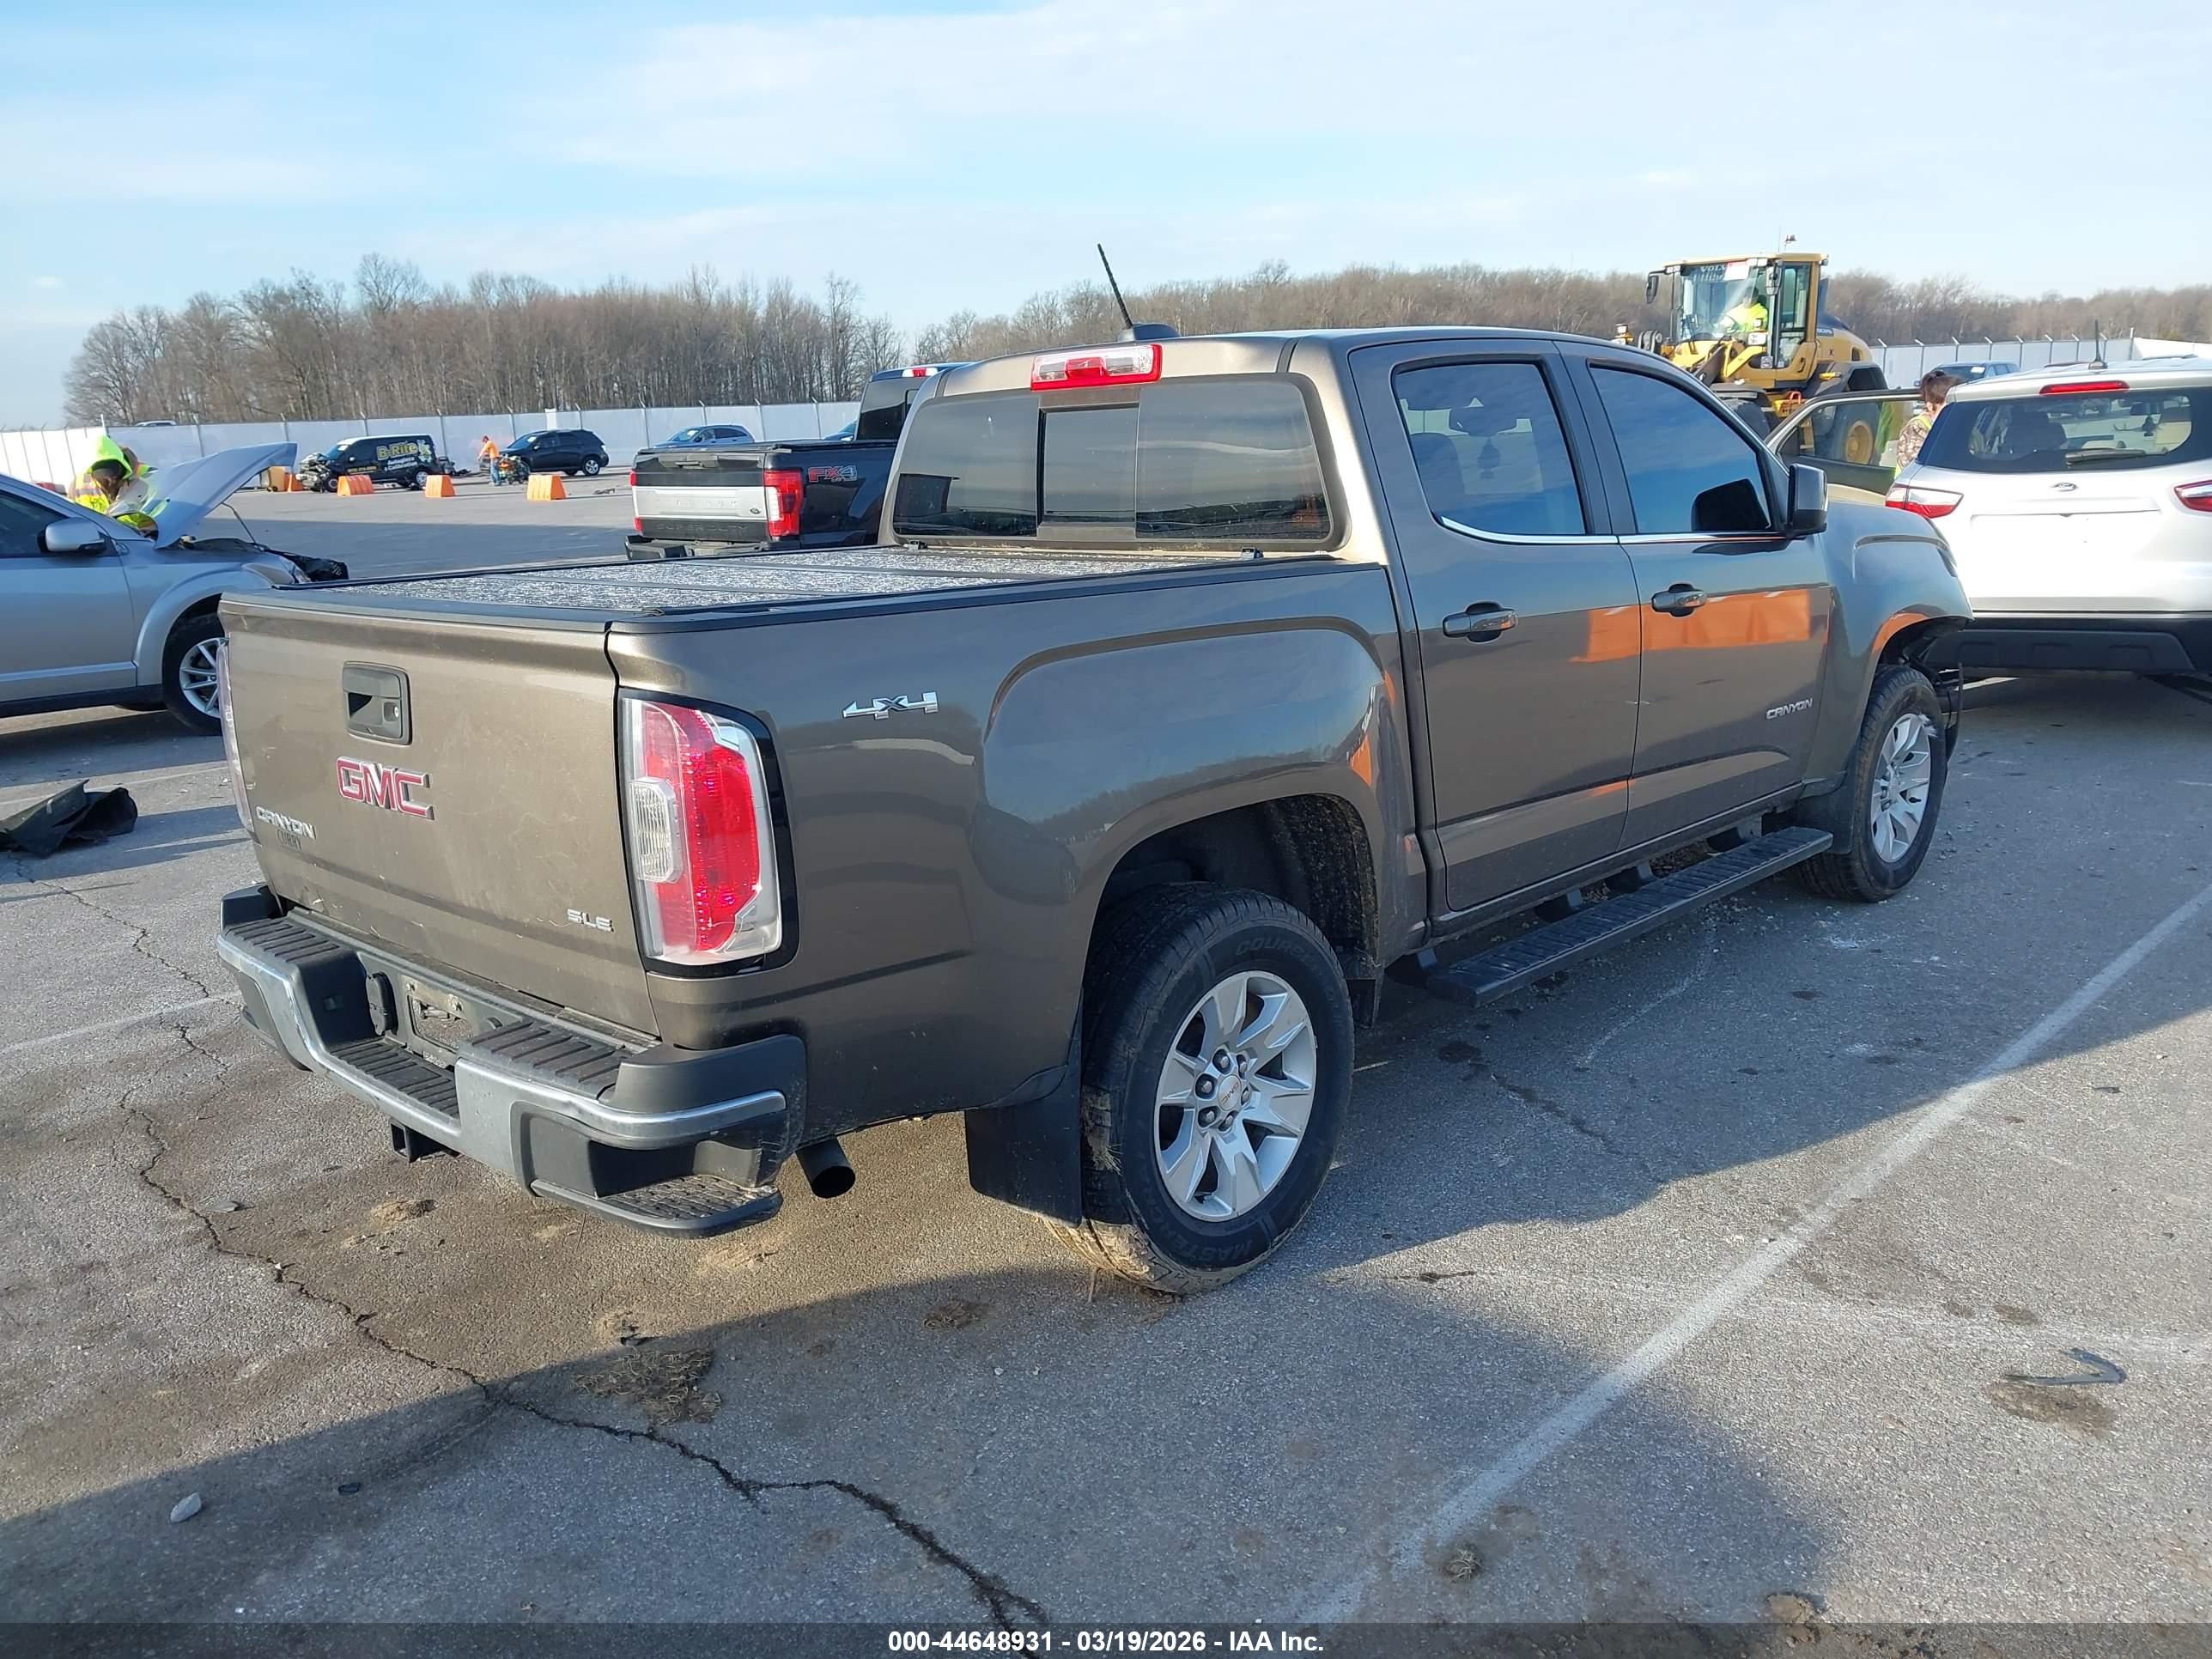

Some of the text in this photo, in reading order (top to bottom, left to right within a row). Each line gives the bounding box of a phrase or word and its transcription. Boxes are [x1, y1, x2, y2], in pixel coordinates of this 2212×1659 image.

[377, 441, 418, 460] B-Rite
[808, 465, 858, 483] FX4
[1765, 697, 1813, 720] CANYON
[336, 756, 434, 820] GMC
[257, 805, 316, 840] CANYON
[276, 828, 303, 850] CURRY
[567, 908, 614, 933] SLE
[1221, 1081, 1239, 1104] GMC
